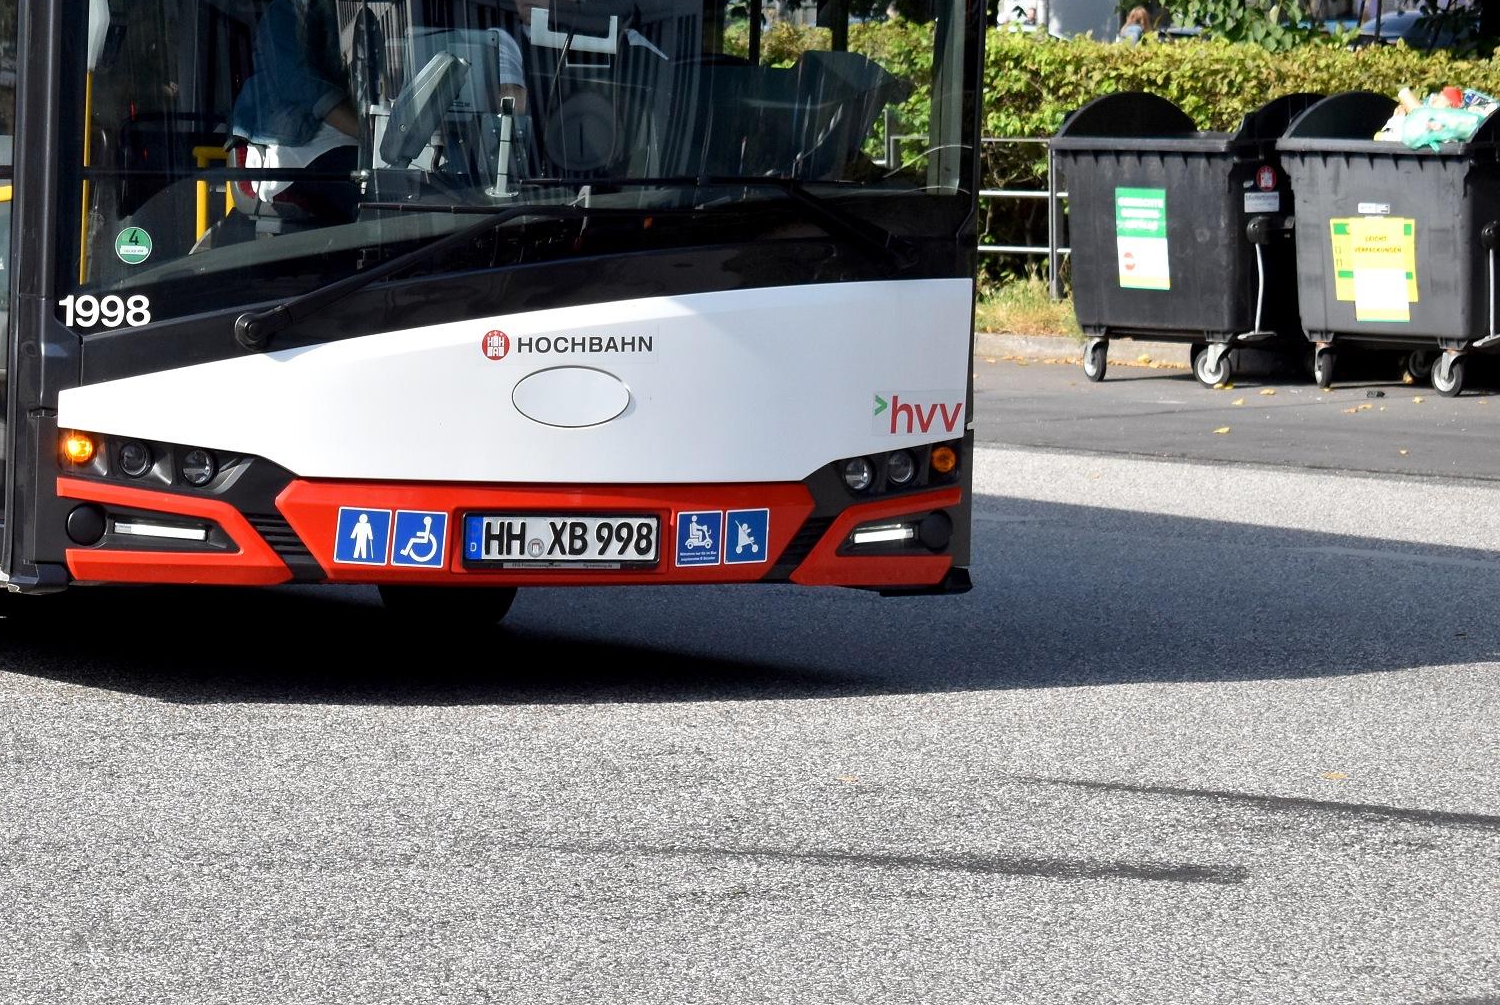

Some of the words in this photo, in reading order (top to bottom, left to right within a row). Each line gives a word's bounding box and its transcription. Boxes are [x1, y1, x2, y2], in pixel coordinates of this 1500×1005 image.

[128, 229, 140, 246] 4
[58, 294, 151, 328] 1998
[517, 336, 653, 353] HOCHBAHN
[890, 395, 963, 434] hvv
[470, 542, 477, 552] D
[484, 521, 526, 556] HH
[547, 521, 588, 556] XB
[595, 521, 654, 556] 998
